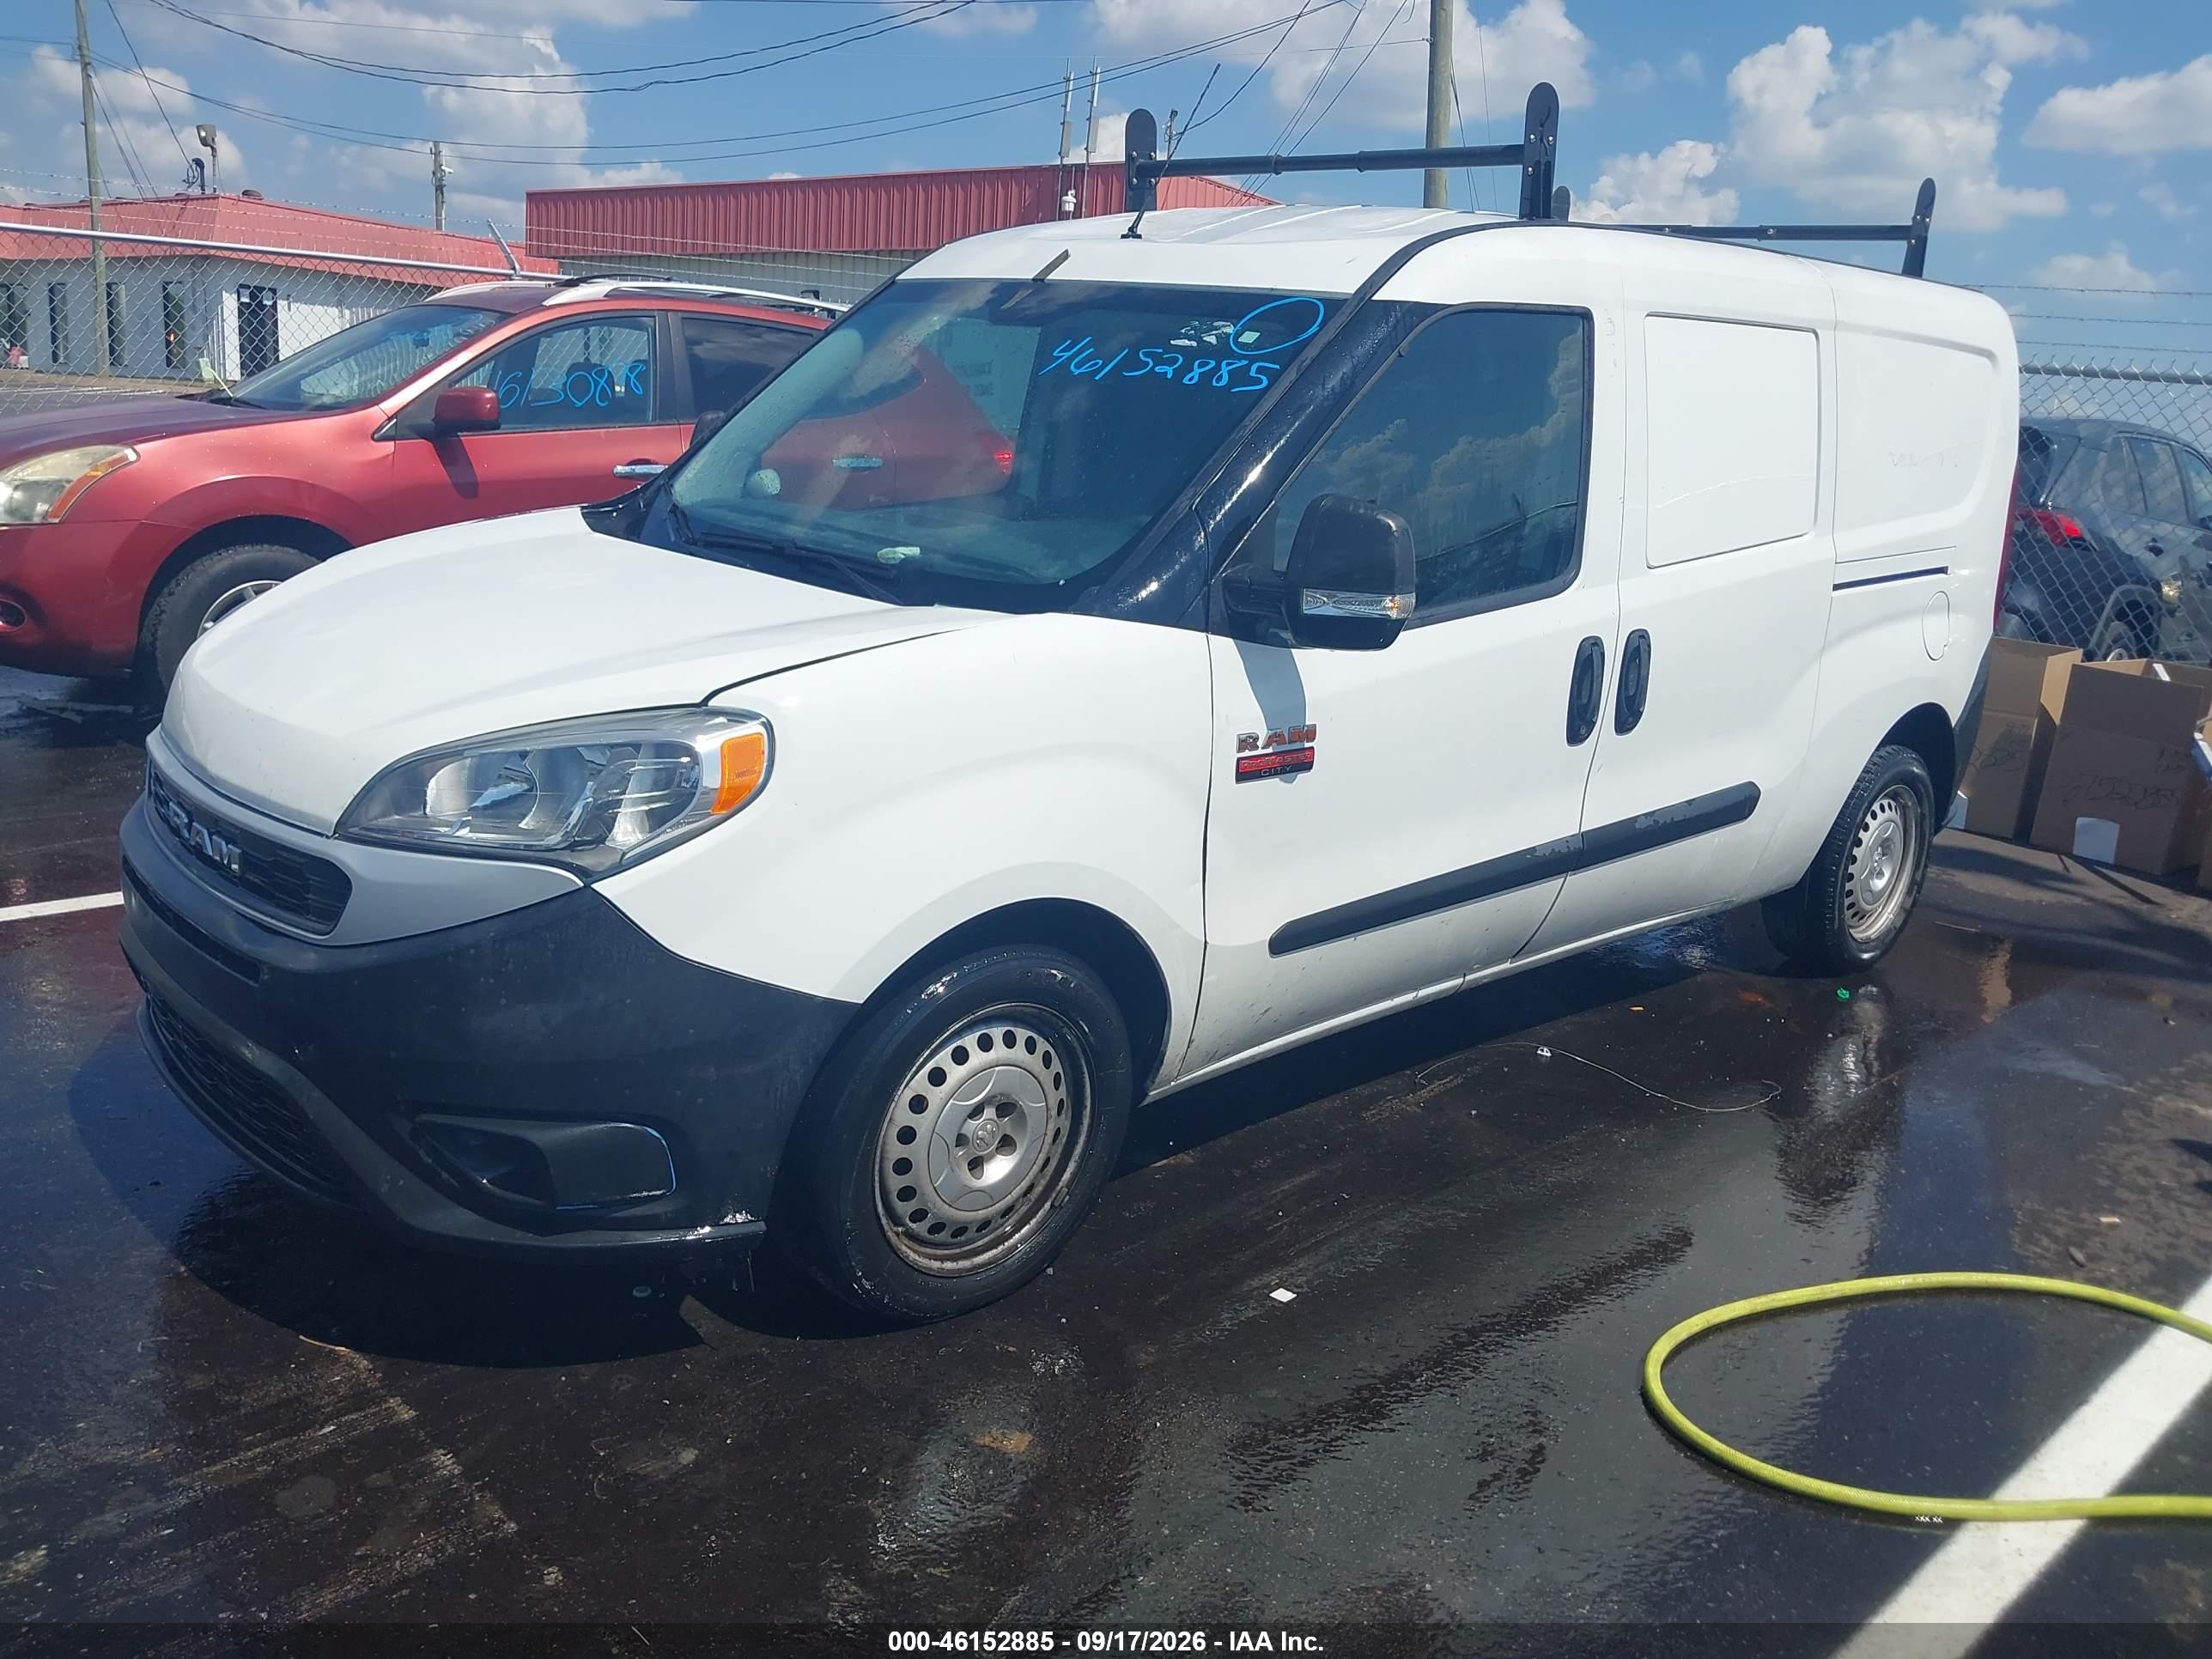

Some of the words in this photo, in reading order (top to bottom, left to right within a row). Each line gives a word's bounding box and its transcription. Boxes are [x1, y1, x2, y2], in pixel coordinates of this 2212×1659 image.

[1038, 337, 1280, 392] 46152885
[1237, 723, 1317, 754] RAM
[1261, 764, 1292, 776] CITY
[169, 801, 244, 874] RAM
